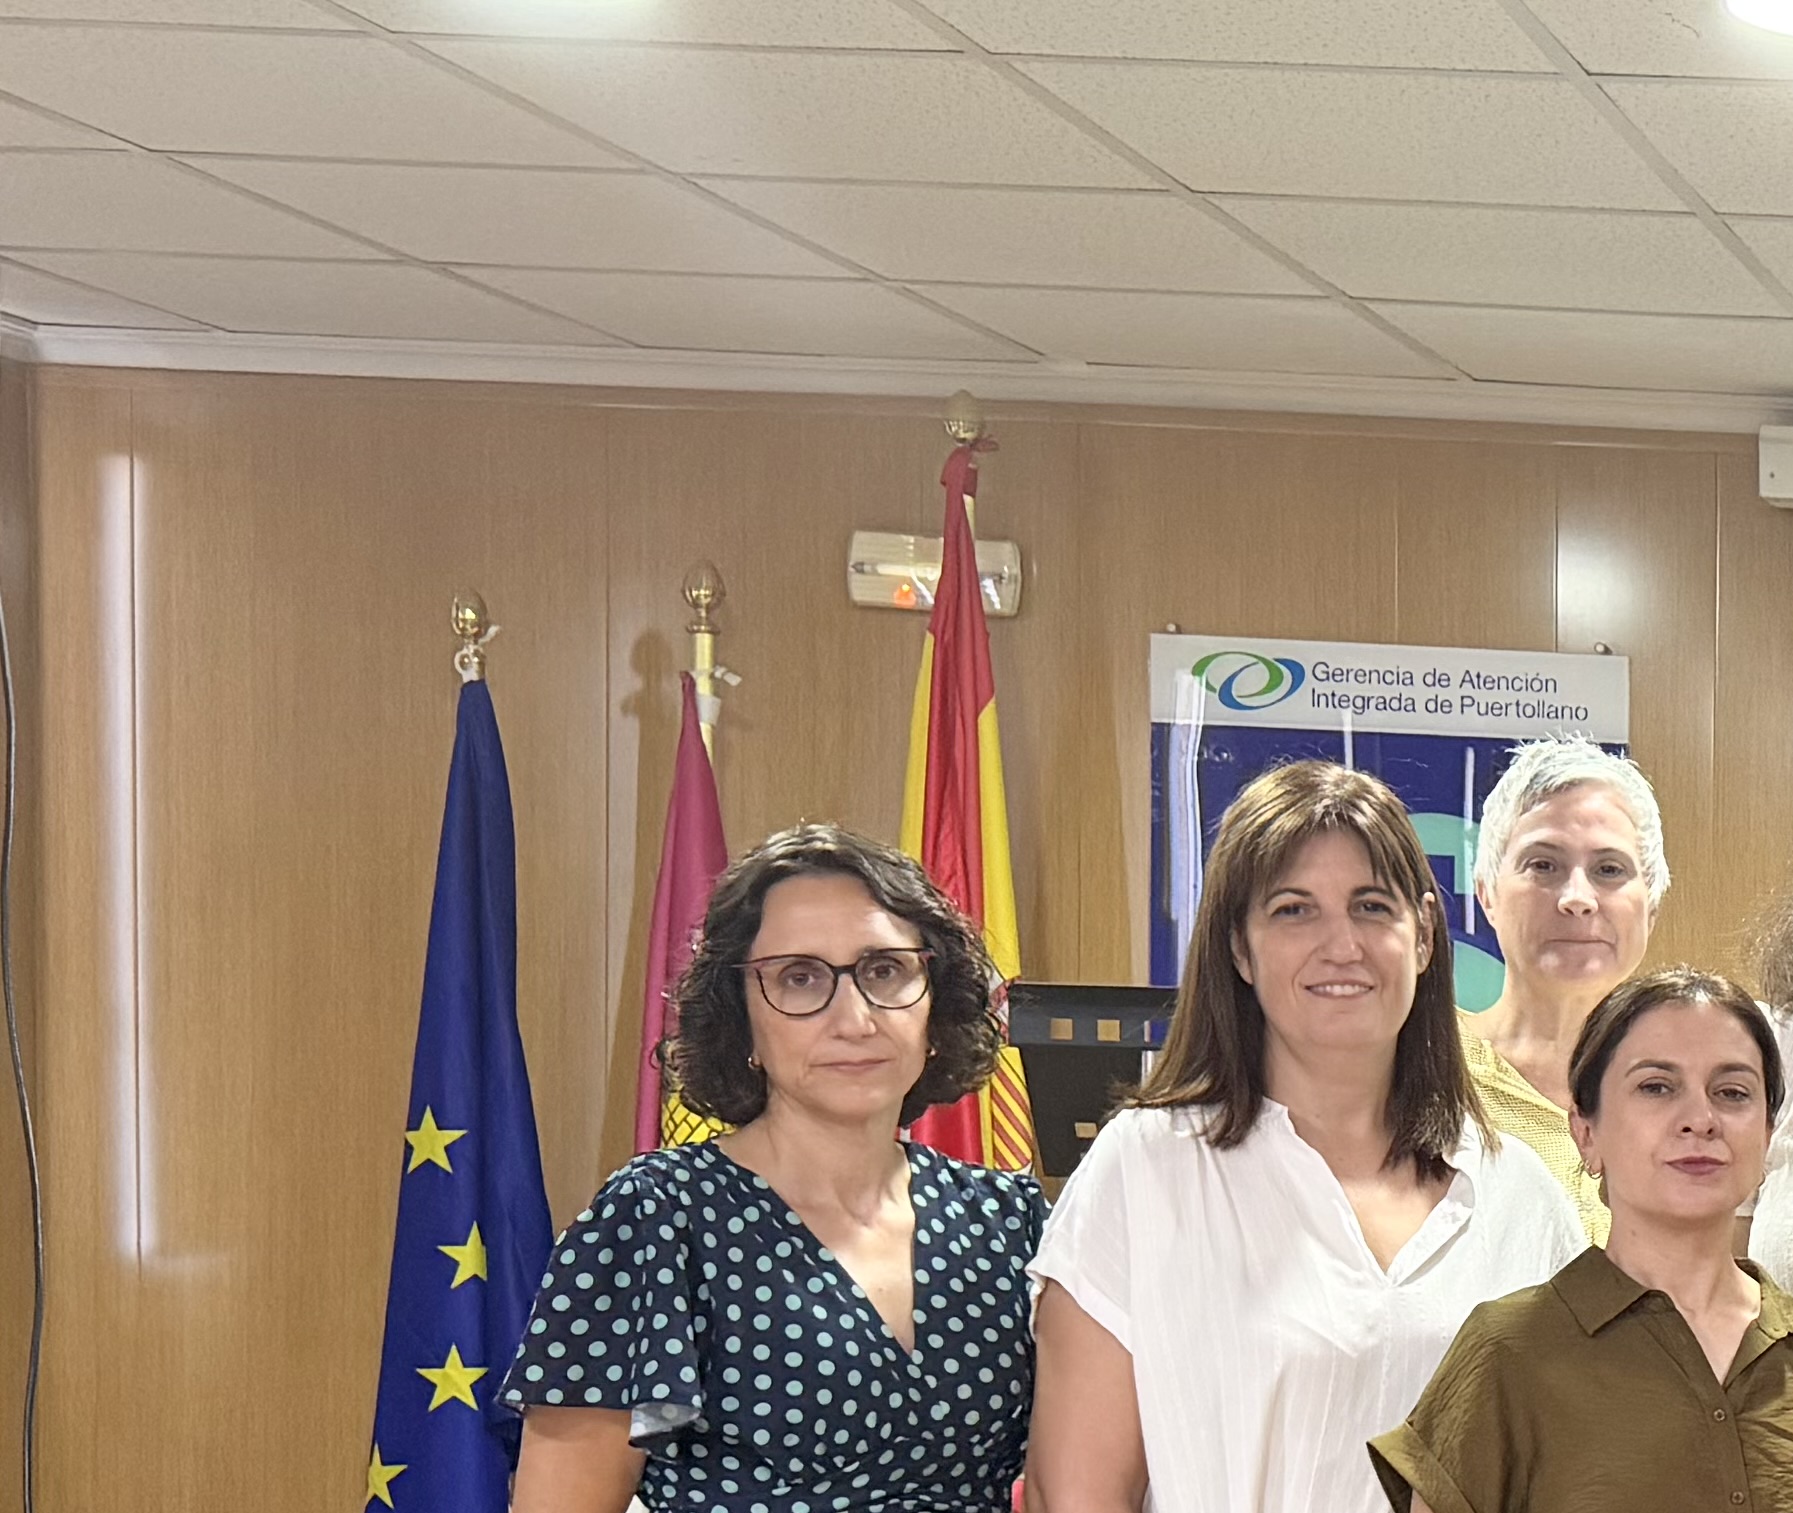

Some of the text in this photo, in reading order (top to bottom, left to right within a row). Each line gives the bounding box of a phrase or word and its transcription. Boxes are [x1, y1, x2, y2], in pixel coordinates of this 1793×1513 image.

[1311, 661, 1558, 694] Gerencia de Atención
[1311, 687, 1589, 722] Integrada de Puertollano
